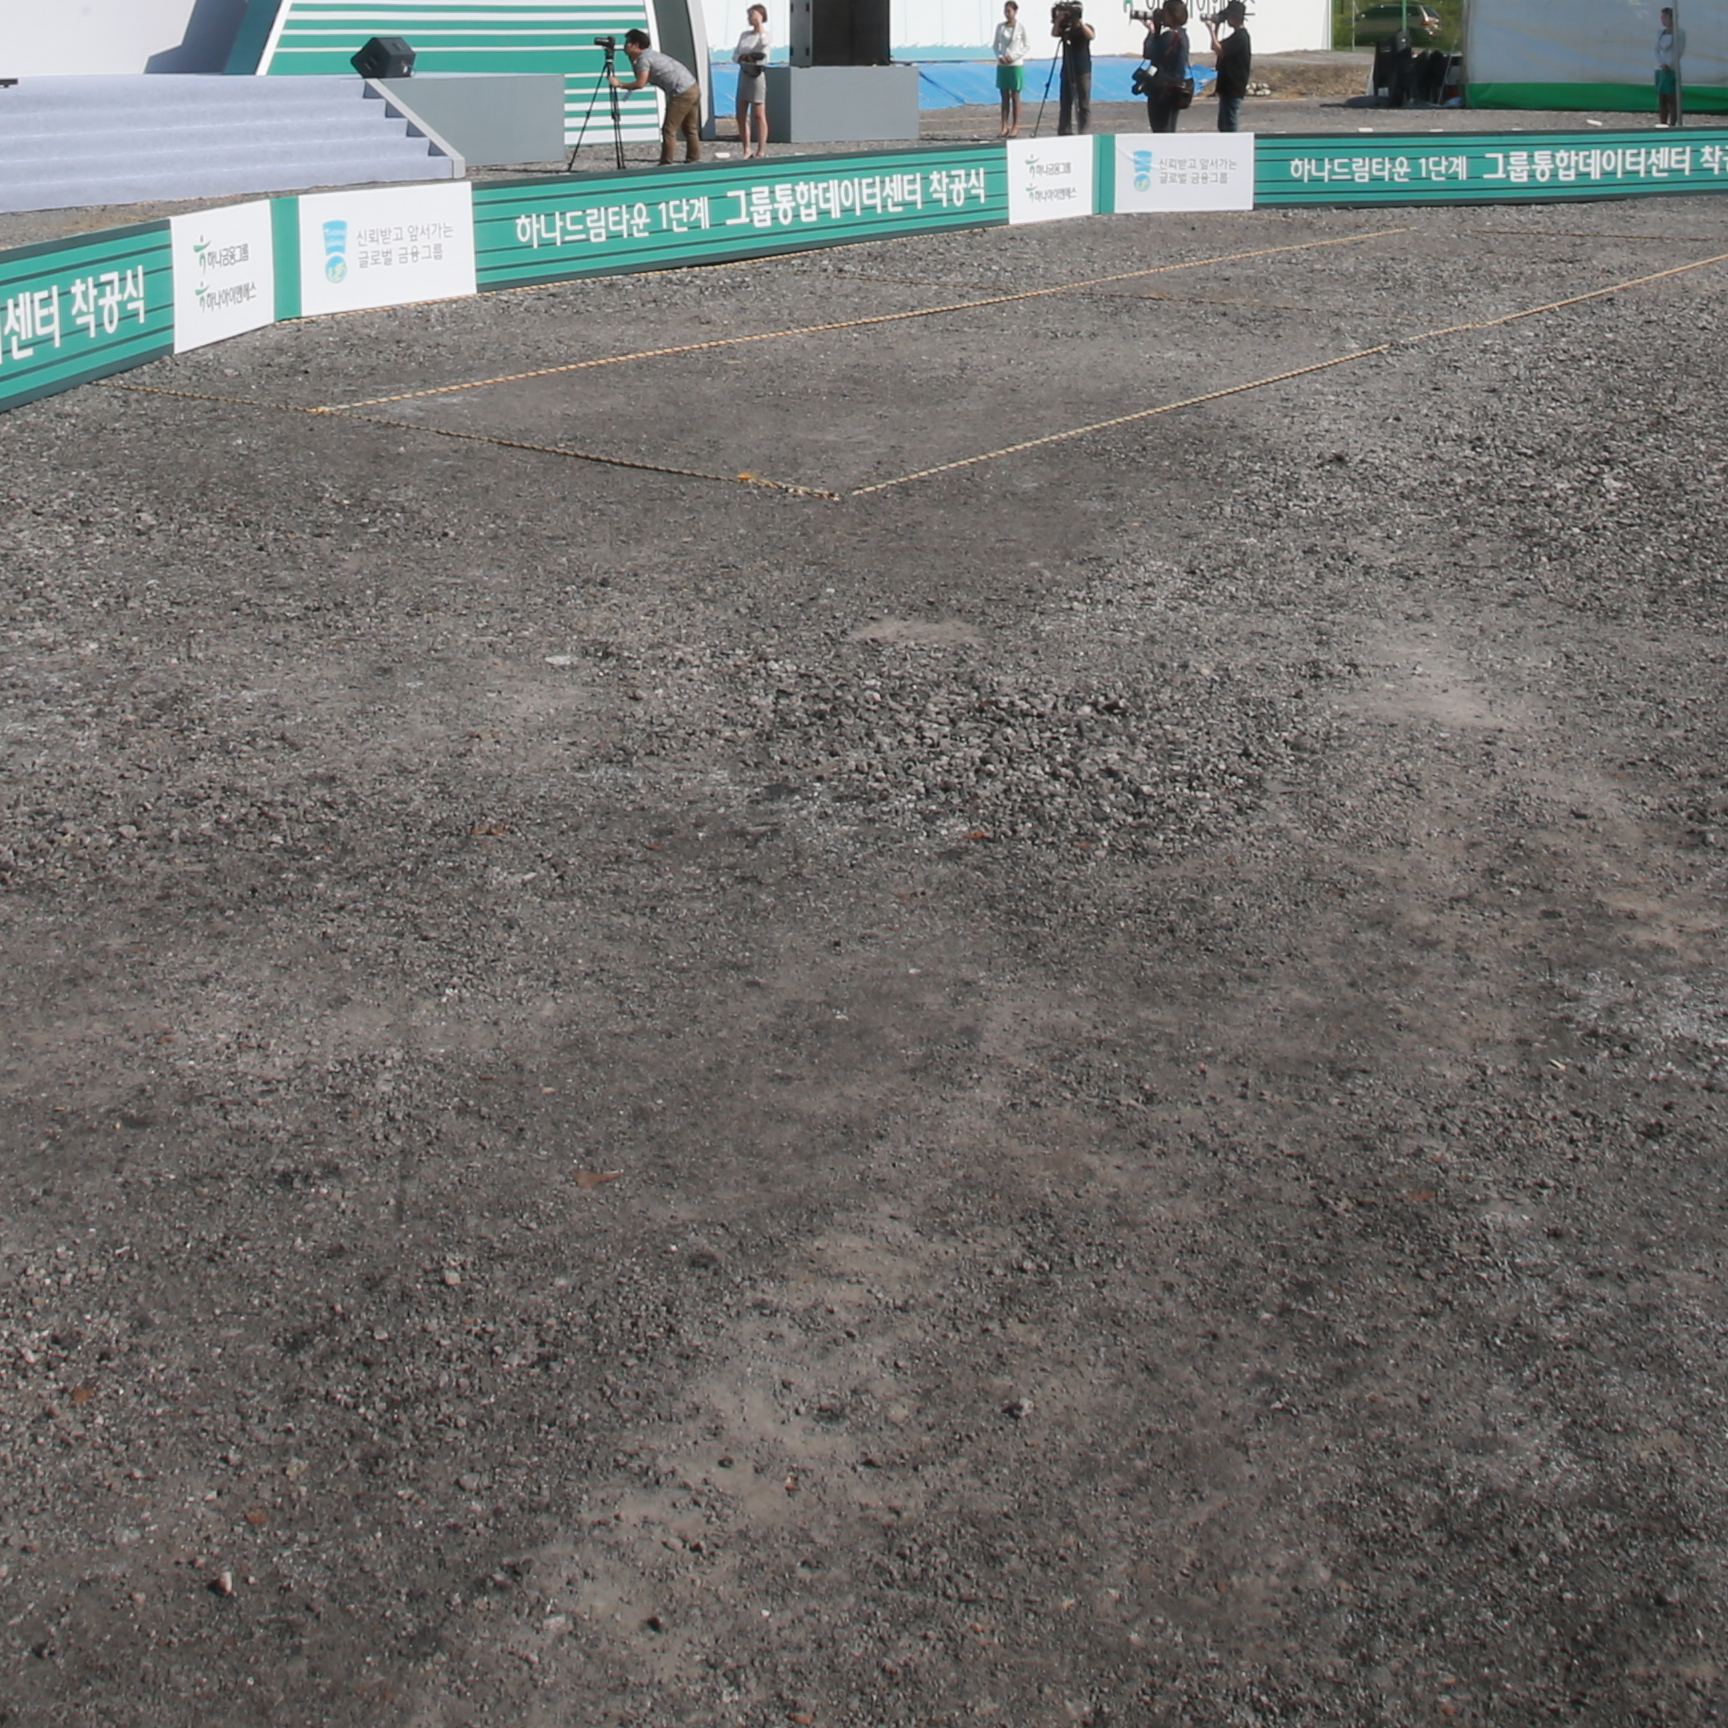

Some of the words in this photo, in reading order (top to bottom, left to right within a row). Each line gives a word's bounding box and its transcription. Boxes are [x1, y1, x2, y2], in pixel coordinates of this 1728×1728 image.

[1290, 156, 1411, 183] 하나드림타운
[1419, 155, 1467, 181] 1단계
[1482, 145, 1691, 183] 그룹통합데이터센터
[515, 202, 651, 249] 하나드림타운
[658, 196, 710, 232] 1단계
[725, 173, 922, 228] 그룹통합데이터센터
[928, 167, 986, 207] 착공식
[356, 226, 403, 247] 신뢰받고
[407, 222, 454, 241] 앞서가는
[207, 243, 249, 269] 하나금융그룹
[358, 248, 393, 269] 글로벌
[397, 243, 444, 264] 금융그룹
[71, 265, 145, 338] 착공식
